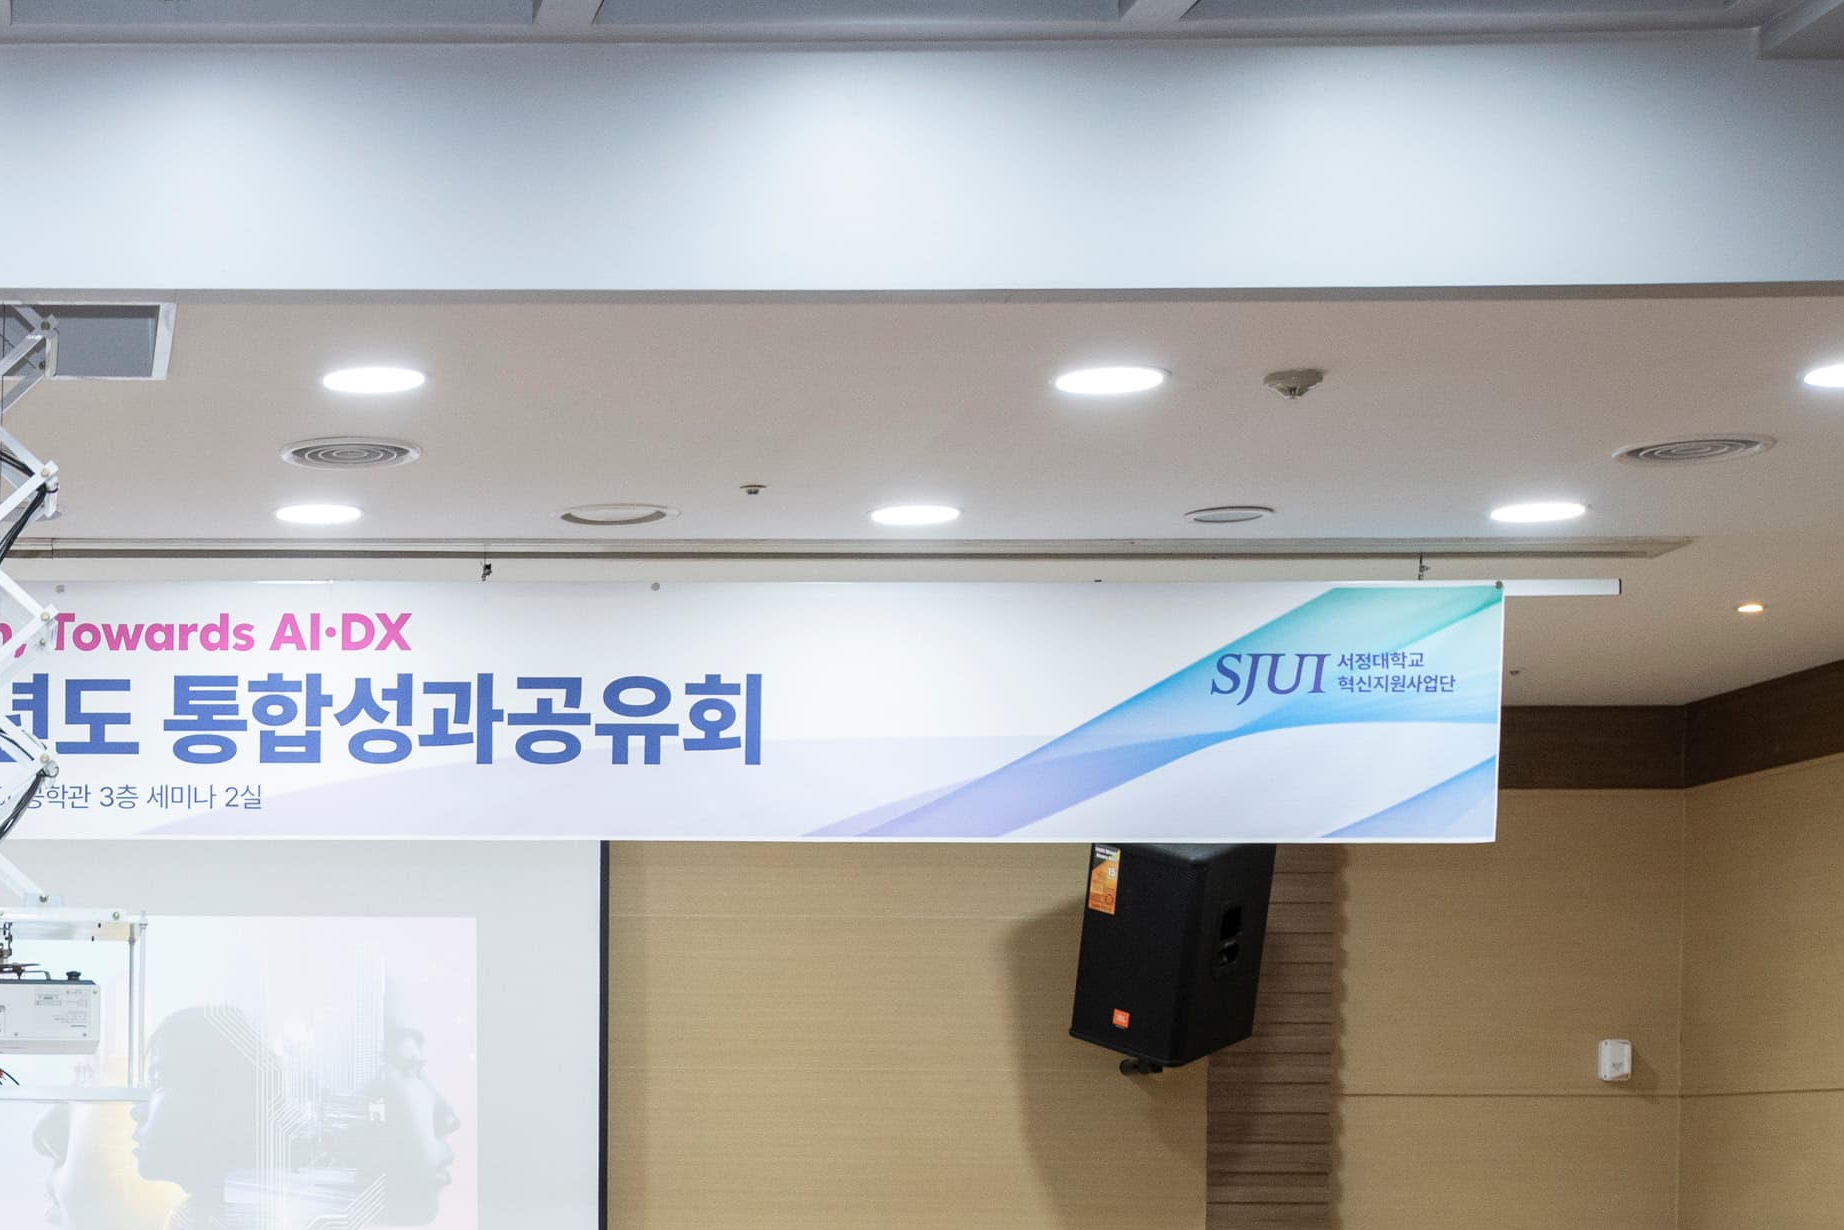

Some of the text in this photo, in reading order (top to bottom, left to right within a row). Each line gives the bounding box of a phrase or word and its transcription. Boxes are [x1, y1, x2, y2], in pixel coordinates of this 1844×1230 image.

[53, 613, 255, 652] Towards
[1338, 652, 1424, 670] 서정대학교
[1210, 653, 1331, 706] SJUI
[1338, 674, 1456, 693] 혁신지원사업단
[163, 672, 763, 766] 통합성과공유회
[99, 784, 138, 809] 3층
[146, 784, 217, 810] 세미나
[224, 784, 263, 810] 2실
